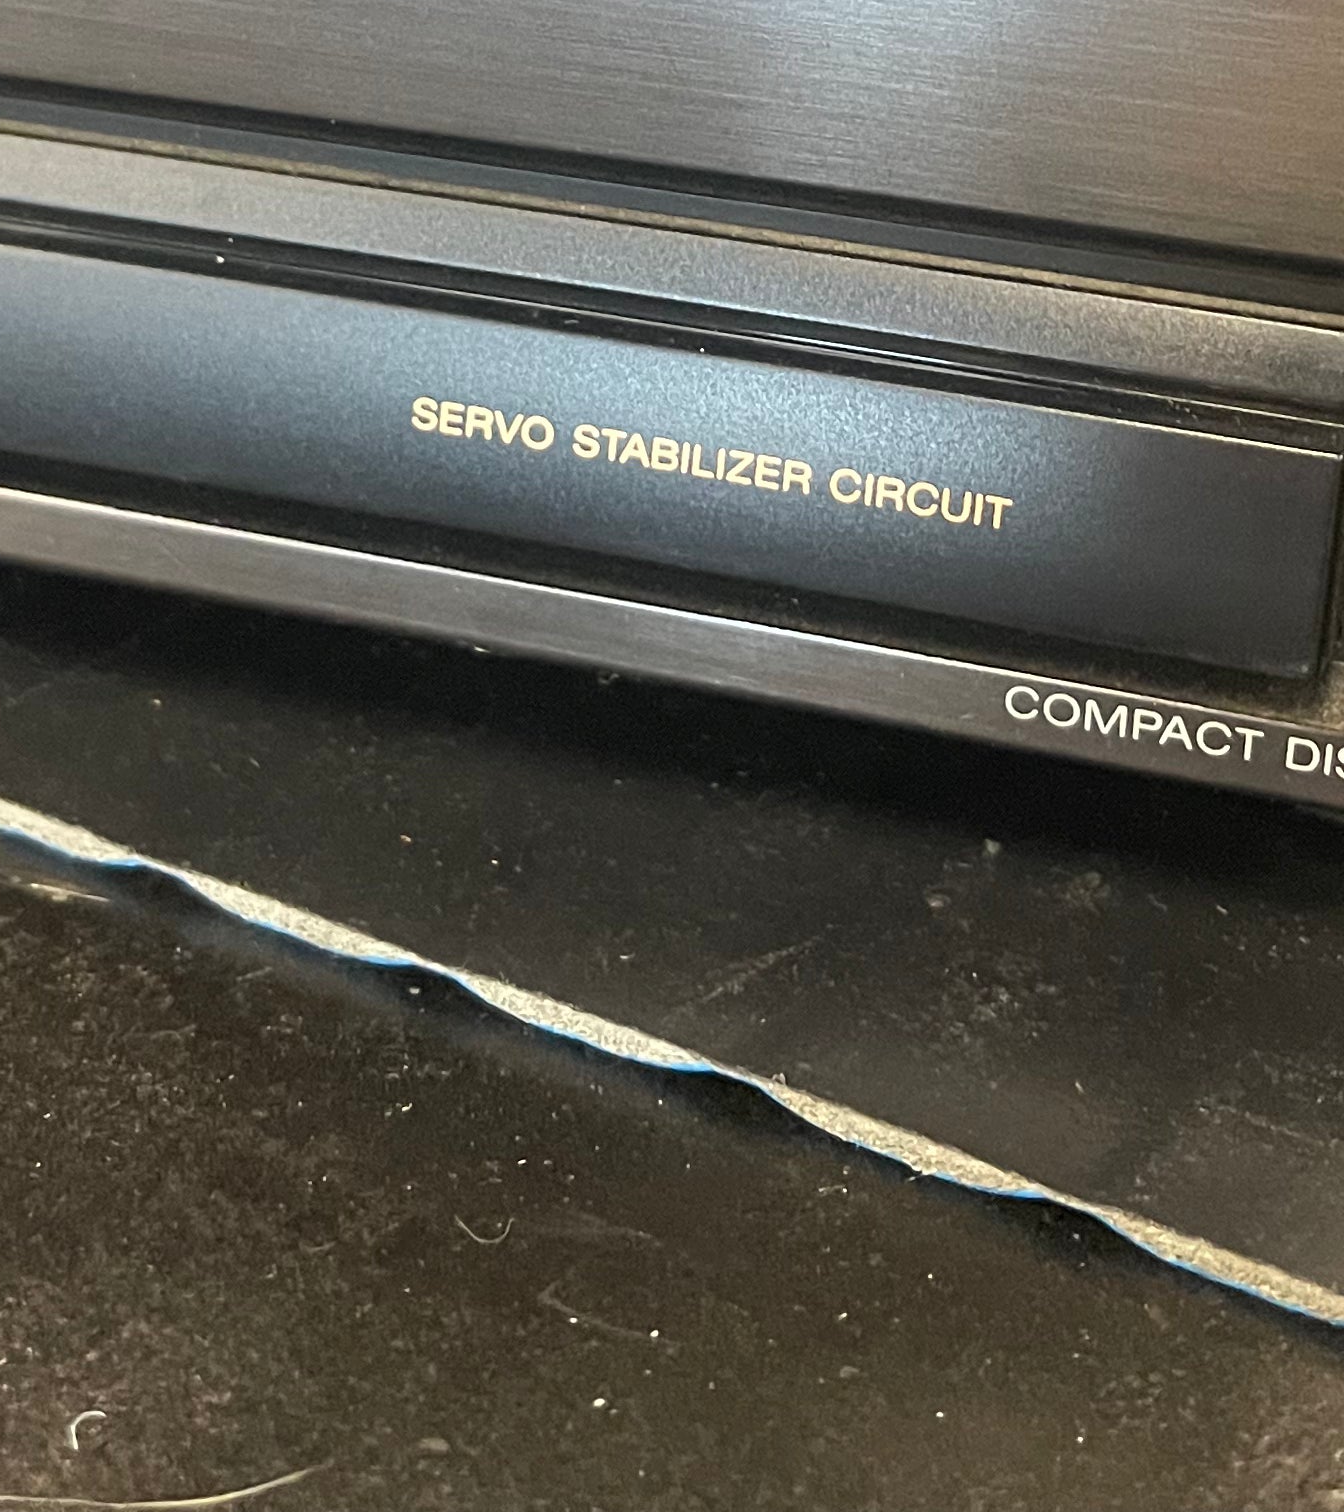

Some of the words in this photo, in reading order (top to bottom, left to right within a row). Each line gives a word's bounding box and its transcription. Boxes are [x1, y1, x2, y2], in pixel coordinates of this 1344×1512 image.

[411, 396, 555, 451] SERVO
[571, 422, 812, 495] STABILIZER
[828, 467, 1013, 530] CIRCUIT
[1004, 685, 1265, 762] COMPACT
